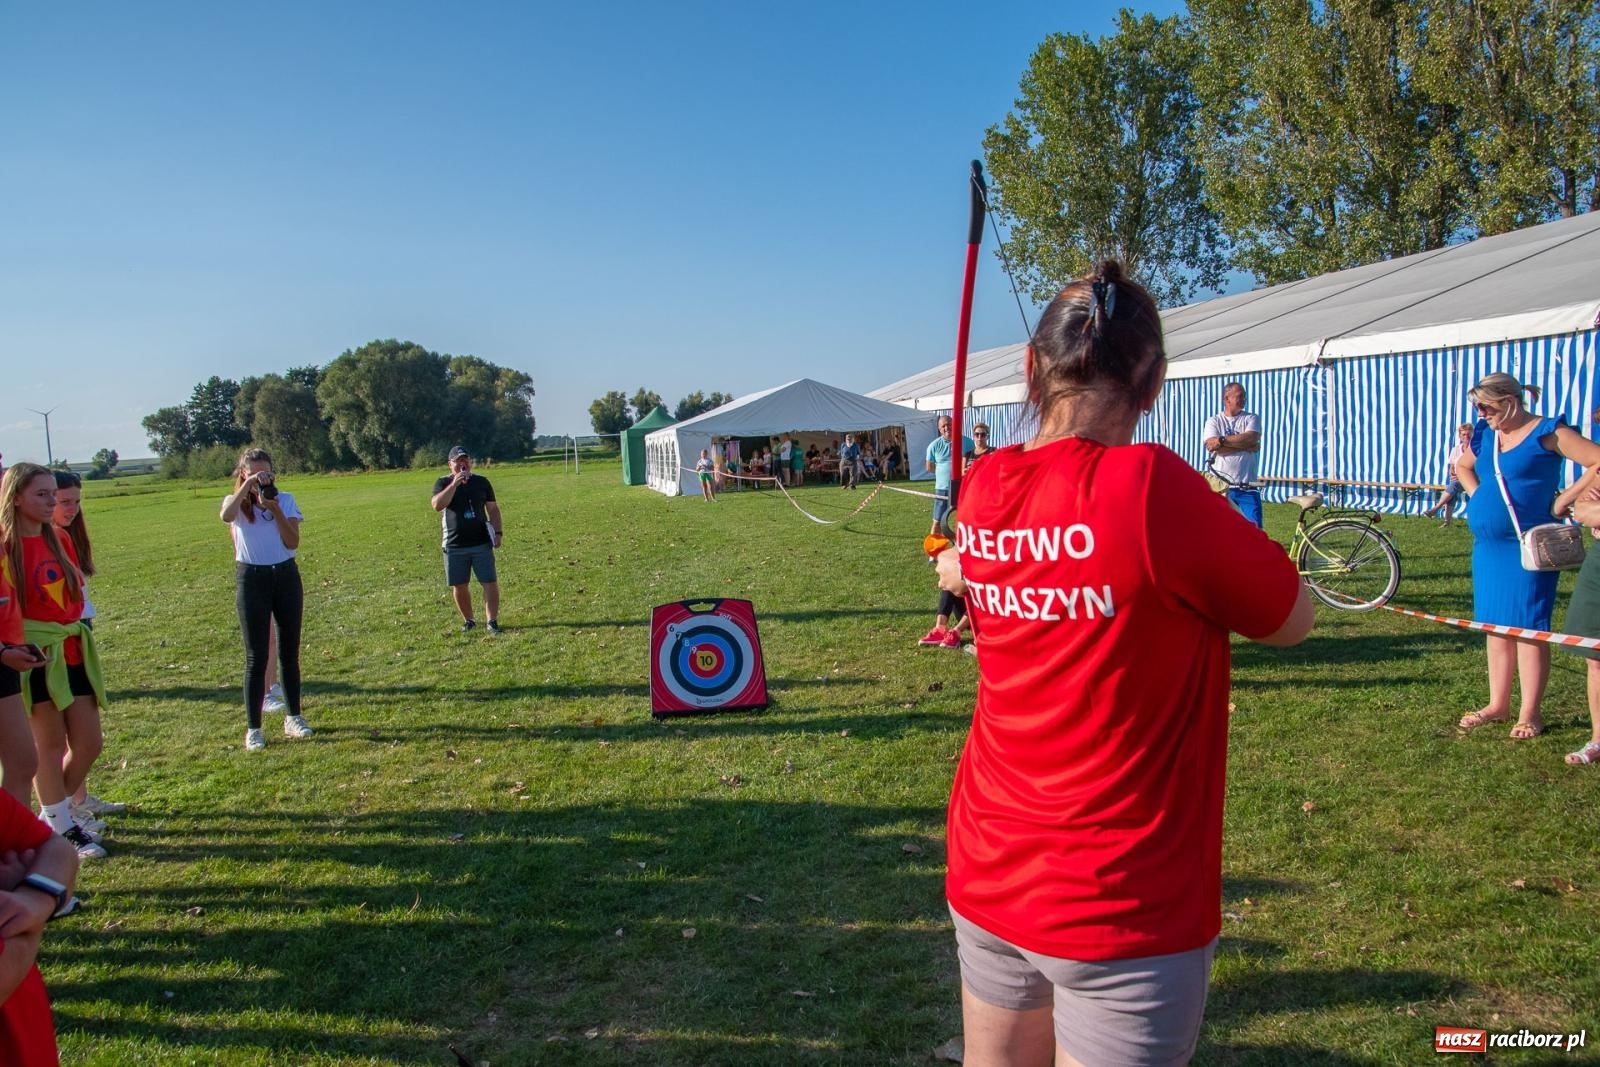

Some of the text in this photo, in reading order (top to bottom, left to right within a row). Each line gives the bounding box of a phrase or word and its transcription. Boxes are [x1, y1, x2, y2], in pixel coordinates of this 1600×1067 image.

[957, 522, 1095, 562] OŁECTWO
[669, 624, 675, 633] 6
[691, 646, 698, 654] 9
[700, 655, 713, 667] 10
